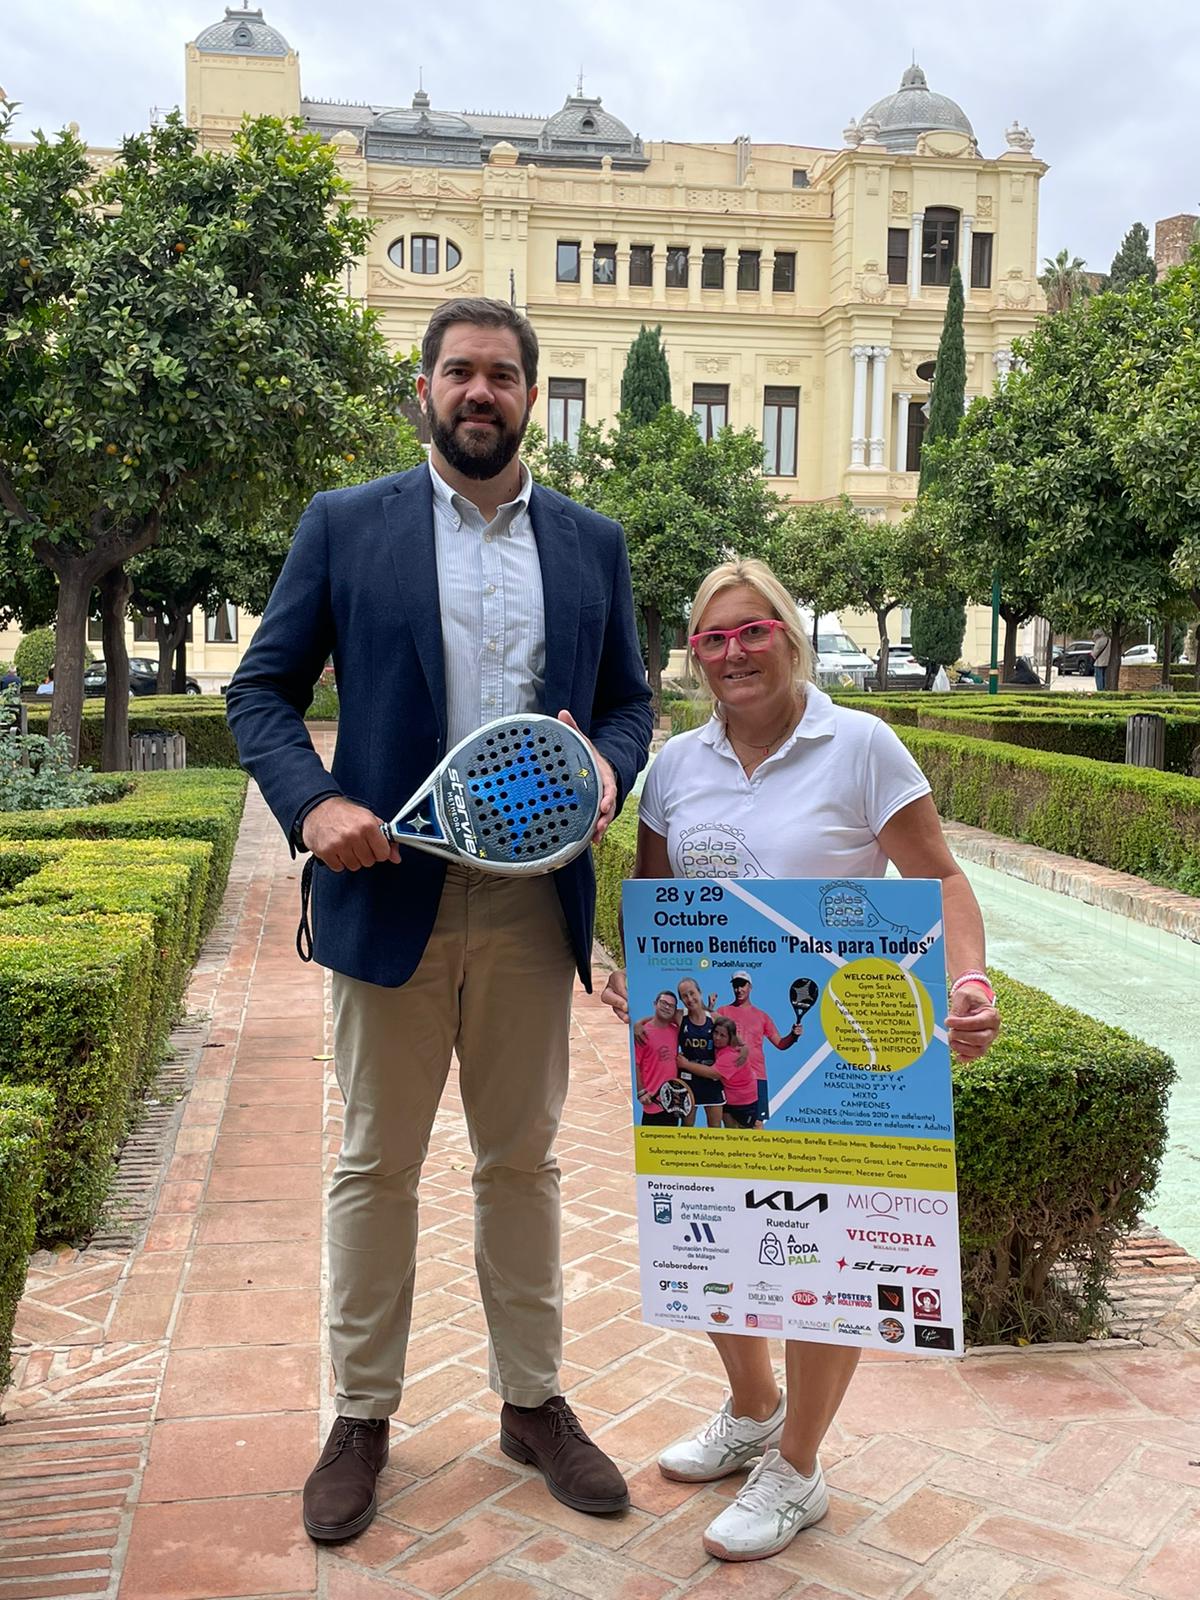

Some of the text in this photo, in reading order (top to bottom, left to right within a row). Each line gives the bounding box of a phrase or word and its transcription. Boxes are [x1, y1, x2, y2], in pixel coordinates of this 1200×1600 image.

[447, 791, 461, 832] METHEORA
[448, 768, 477, 854] starvie
[682, 836, 736, 854] palas
[682, 855, 736, 868] para
[685, 866, 738, 879] todos
[656, 886, 723, 905] 28 y 29
[824, 893, 862, 905] palas
[825, 906, 863, 917] para
[654, 911, 728, 926] Octubre
[826, 917, 864, 927] todos
[637, 935, 934, 957] V Torneo Benéfico "Palas para Todos"
[825, 1072, 867, 1080] FEMENINO
[824, 1082, 871, 1090] MASCULINO
[841, 1100, 891, 1109] CAMPEONES
[785, 1116, 820, 1124] FAMILIAR
[660, 1159, 699, 1167] Campeones
[856, 1169, 884, 1177] Neceser
[906, 1160, 948, 1169] Carmencita
[648, 1181, 715, 1192] Patrocinadores
[681, 1202, 736, 1212] Ayuntamiento
[847, 1192, 948, 1215] MIOPTICO
[693, 1213, 722, 1222] Málaga
[766, 1218, 810, 1229] Ruedatur
[787, 1234, 796, 1243] A
[846, 1229, 936, 1247] VICTORIA
[787, 1243, 819, 1254] TODA
[653, 1260, 708, 1270] Colaboradores
[852, 1260, 938, 1277] starvie
[794, 1293, 816, 1304] TROPS
[837, 1292, 871, 1301] FOSTER'S
[837, 1299, 872, 1308] HOLLYWOOD
